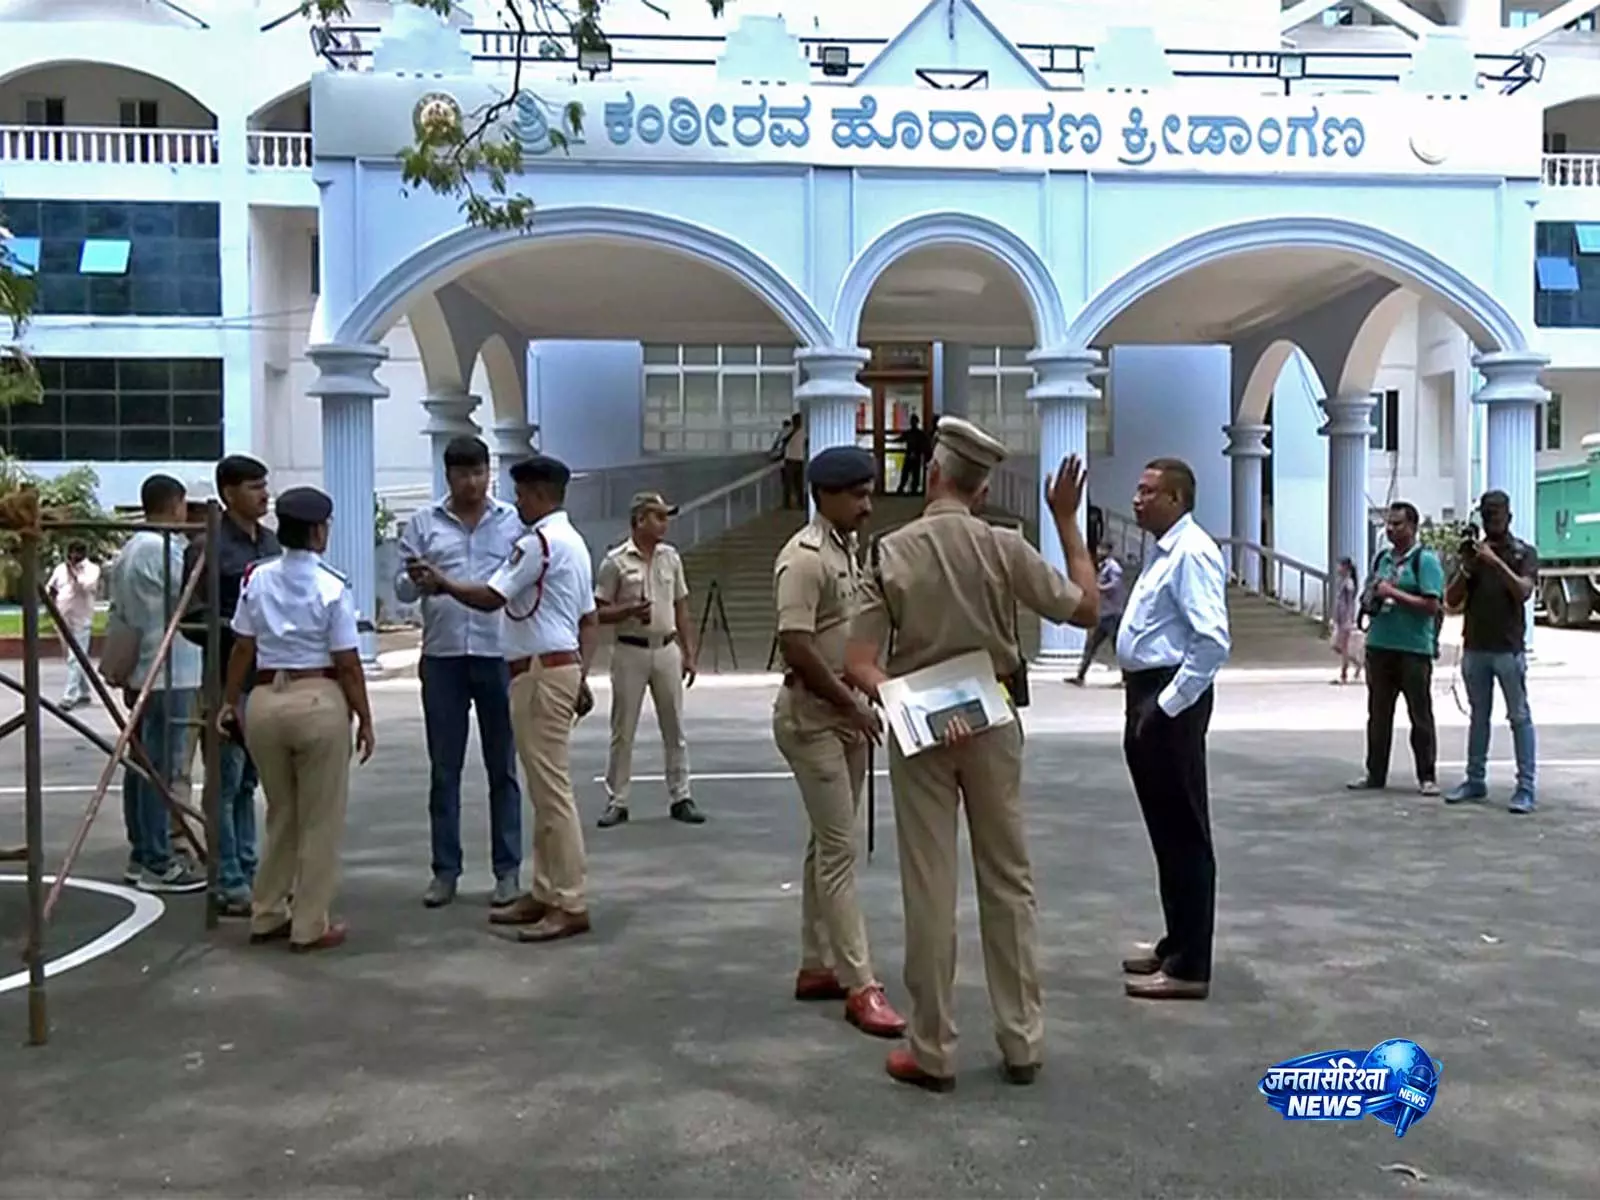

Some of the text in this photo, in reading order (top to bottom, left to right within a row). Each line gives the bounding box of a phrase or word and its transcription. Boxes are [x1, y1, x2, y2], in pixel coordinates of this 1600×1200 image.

[604, 91, 811, 147] ಕಂಠೀರವ
[831, 95, 1101, 154] ಹೊರಾಂಗಣ
[1118, 106, 1365, 165] ಕ್ರೀಡಾಂಗಣ
